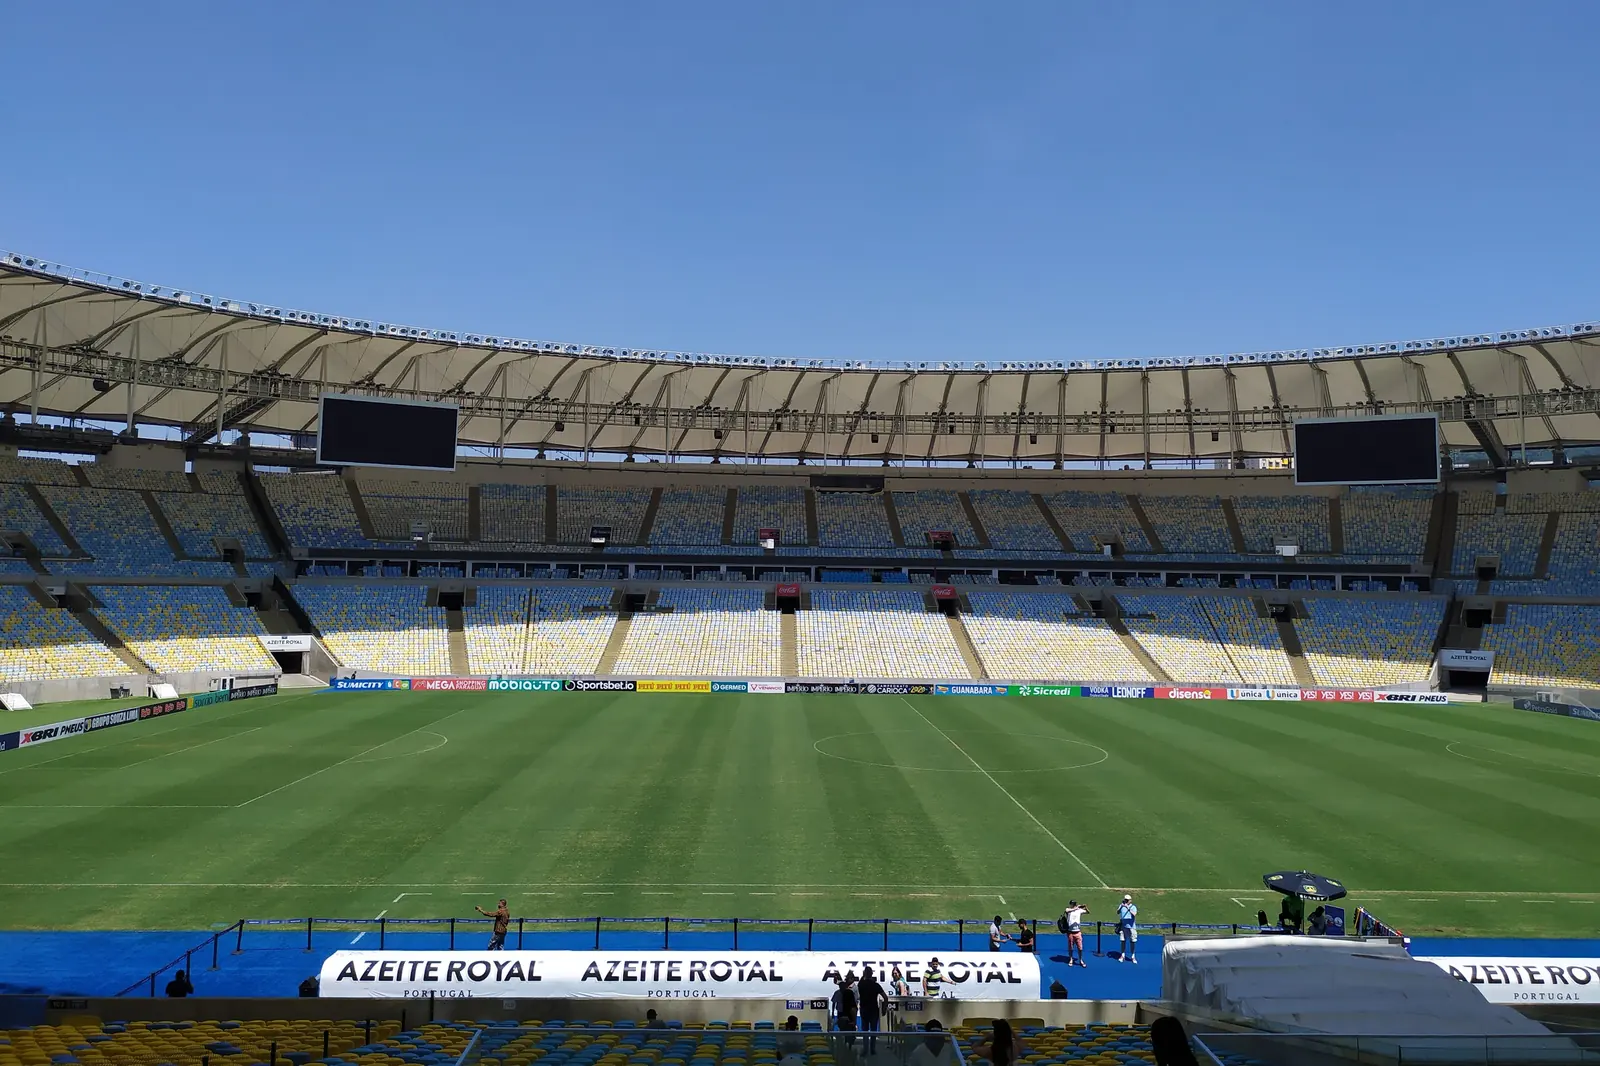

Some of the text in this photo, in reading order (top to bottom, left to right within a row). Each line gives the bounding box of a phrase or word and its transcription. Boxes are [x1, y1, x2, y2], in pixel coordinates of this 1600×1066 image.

[337, 681, 383, 689] SUMICITY
[427, 680, 455, 690] MEGA
[577, 680, 634, 691] Sportsbet.io
[951, 686, 993, 695] GUANABARA
[1033, 687, 1071, 696] Sicredi
[1112, 687, 1147, 698] LEONOFF
[1169, 689, 1212, 700] disensa
[1303, 690, 1318, 699] YES!
[1321, 690, 1336, 699] YES!
[1340, 690, 1355, 700] YES!
[1358, 691, 1373, 700] YES!
[1419, 695, 1447, 703] PNEUS
[91, 716, 110, 728] GRUPO
[110, 713, 127, 725] SOUZA
[127, 708, 138, 720] LIMA
[60, 722, 84, 736] PNEUS
[336, 960, 542, 982] AZEITE ROYAL
[581, 960, 784, 983] AZEITE ROYAL
[404, 989, 474, 998] PORTUGAL
[648, 990, 717, 998] PORTUGAL
[1513, 992, 1580, 1000] PORTUGAL
